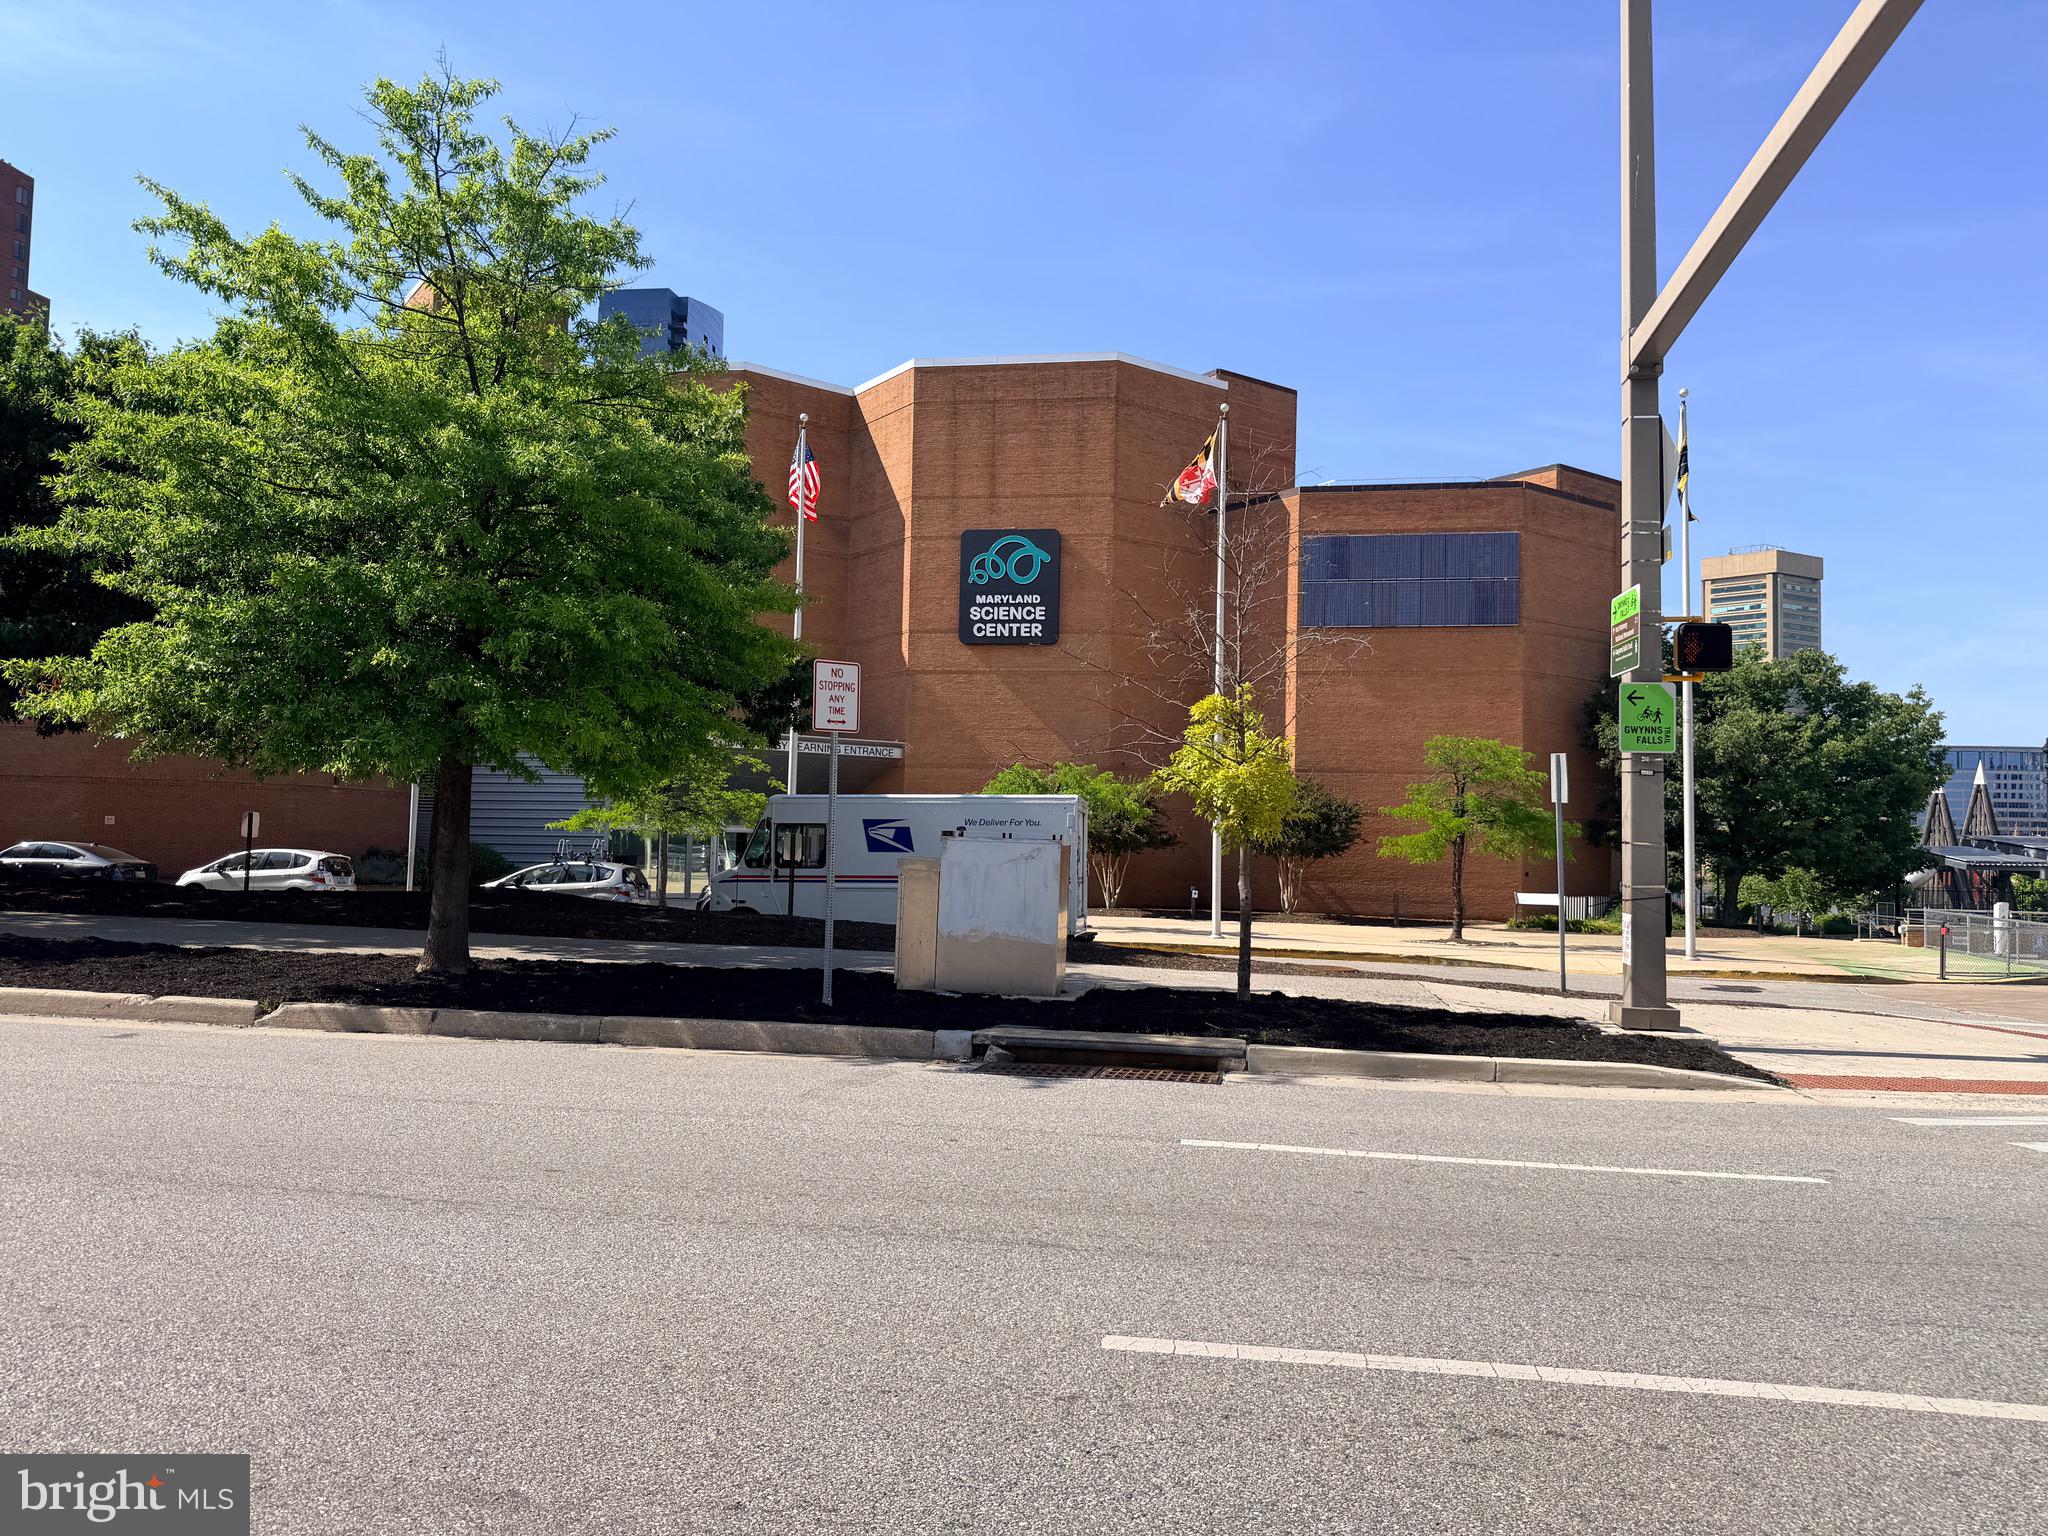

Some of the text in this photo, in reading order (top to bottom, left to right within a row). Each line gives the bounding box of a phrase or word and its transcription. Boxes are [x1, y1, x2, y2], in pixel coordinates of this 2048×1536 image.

[975, 594, 1041, 604] MARYLAND
[969, 606, 1046, 620] SCIENCE
[972, 623, 1043, 637] CENTER
[831, 667, 844, 679] NO
[818, 680, 856, 693] STOPPING
[828, 694, 846, 704] ANY
[828, 705, 846, 716] TIME
[1624, 725, 1663, 734] GWYNNS
[1636, 736, 1663, 745] FALLS
[844, 745, 894, 757] ENTRANCE
[964, 818, 978, 826] We
[978, 818, 1009, 827] Deliver
[1009, 818, 1023, 827] For
